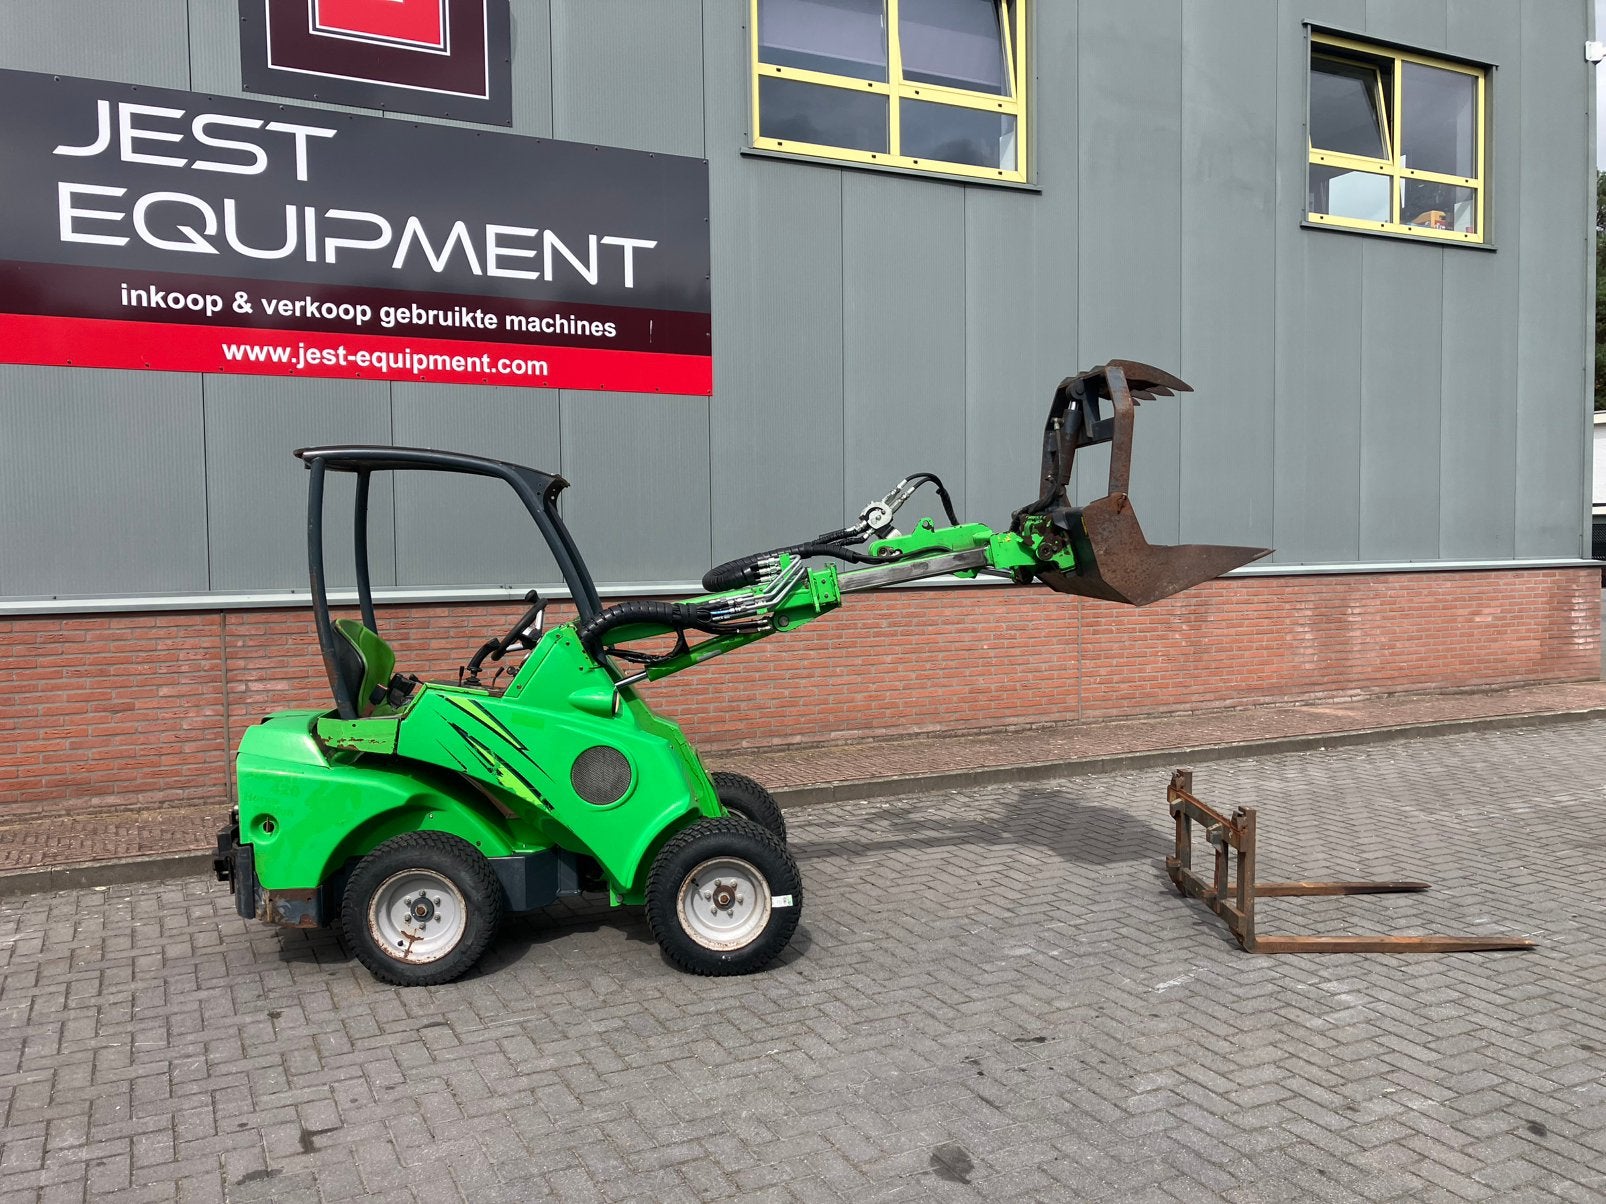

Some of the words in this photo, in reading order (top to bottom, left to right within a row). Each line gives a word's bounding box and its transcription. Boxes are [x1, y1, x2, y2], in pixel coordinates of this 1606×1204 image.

[52, 99, 338, 182] JEST
[57, 181, 658, 289] EQUIPMENT
[121, 282, 223, 317] inkoop
[232, 291, 254, 314] &
[260, 296, 372, 326] verkoop
[379, 303, 498, 329] gebruikte
[505, 313, 617, 338] machines
[221, 343, 549, 376] www.jest-equipment.com
